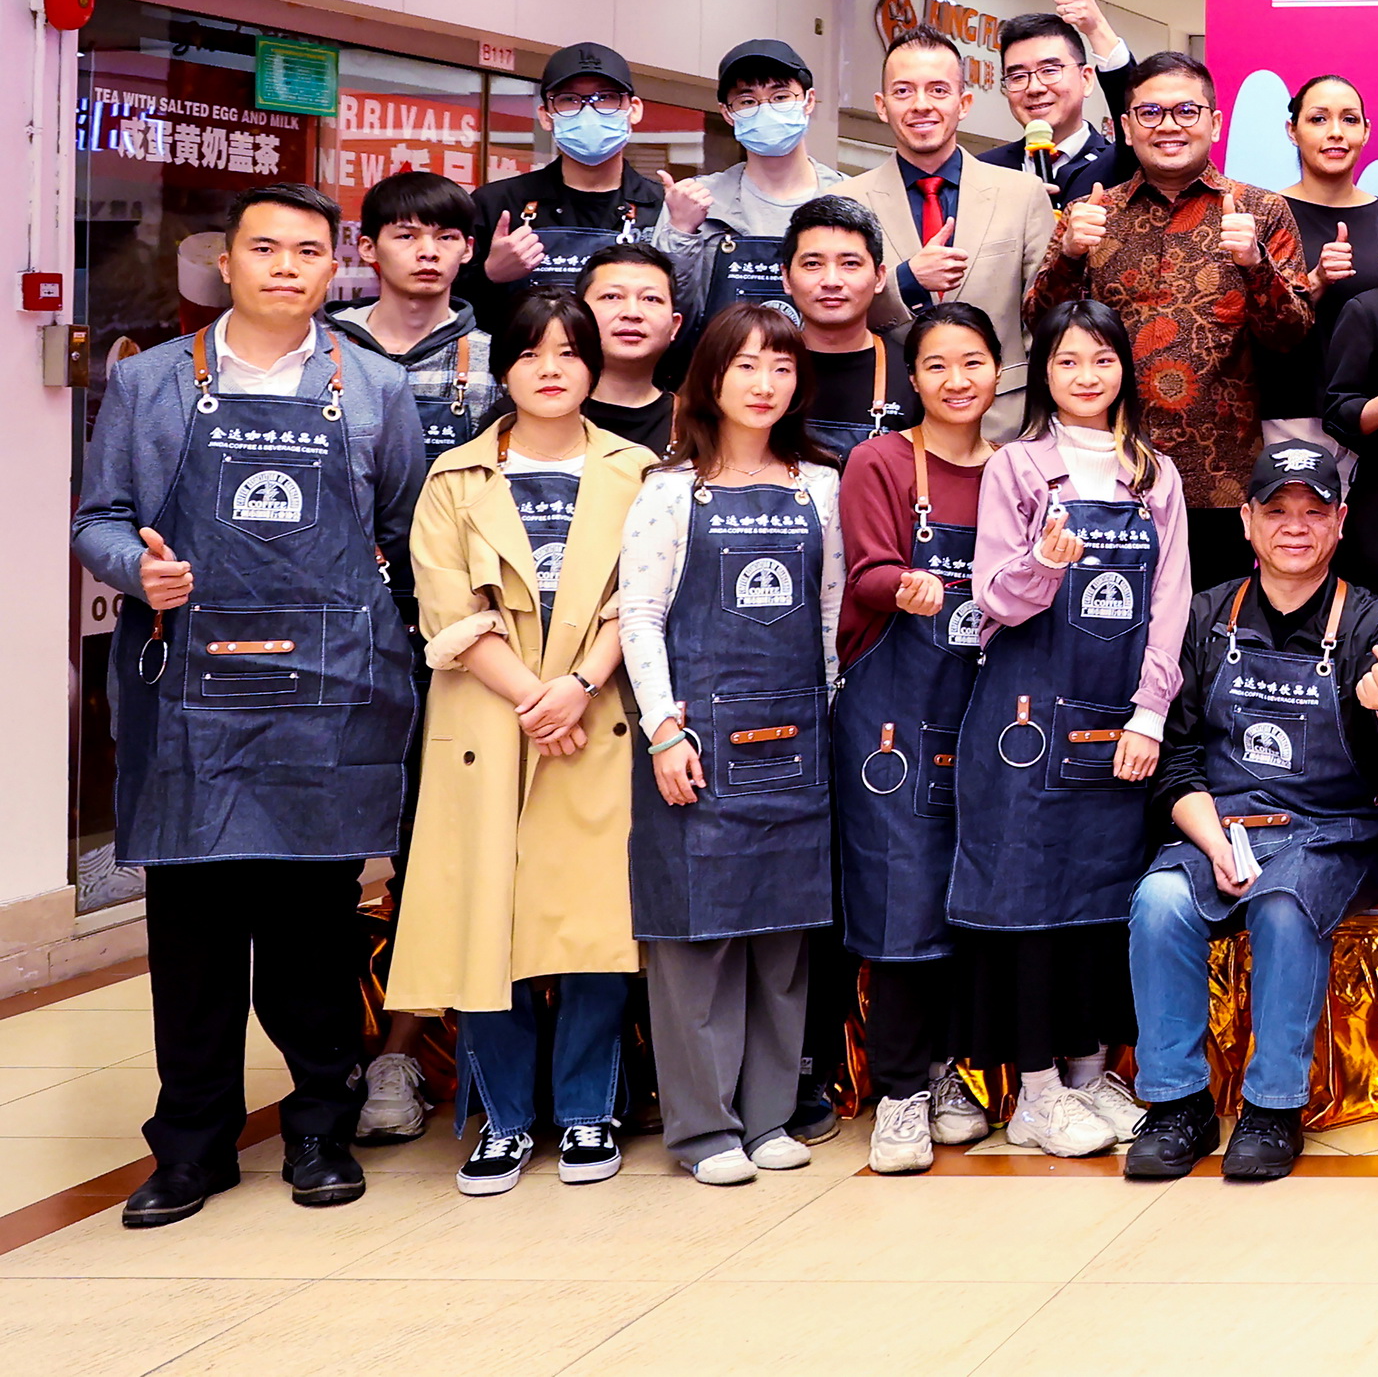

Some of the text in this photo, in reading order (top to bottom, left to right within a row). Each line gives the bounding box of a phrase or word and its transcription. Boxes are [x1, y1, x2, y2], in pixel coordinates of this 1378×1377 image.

[482, 43, 514, 62] B117
[94, 86, 300, 131] TEA WITH SALTED EGG AND MILK
[316, 93, 477, 149] RRIVALS
[319, 146, 386, 190] NEW
